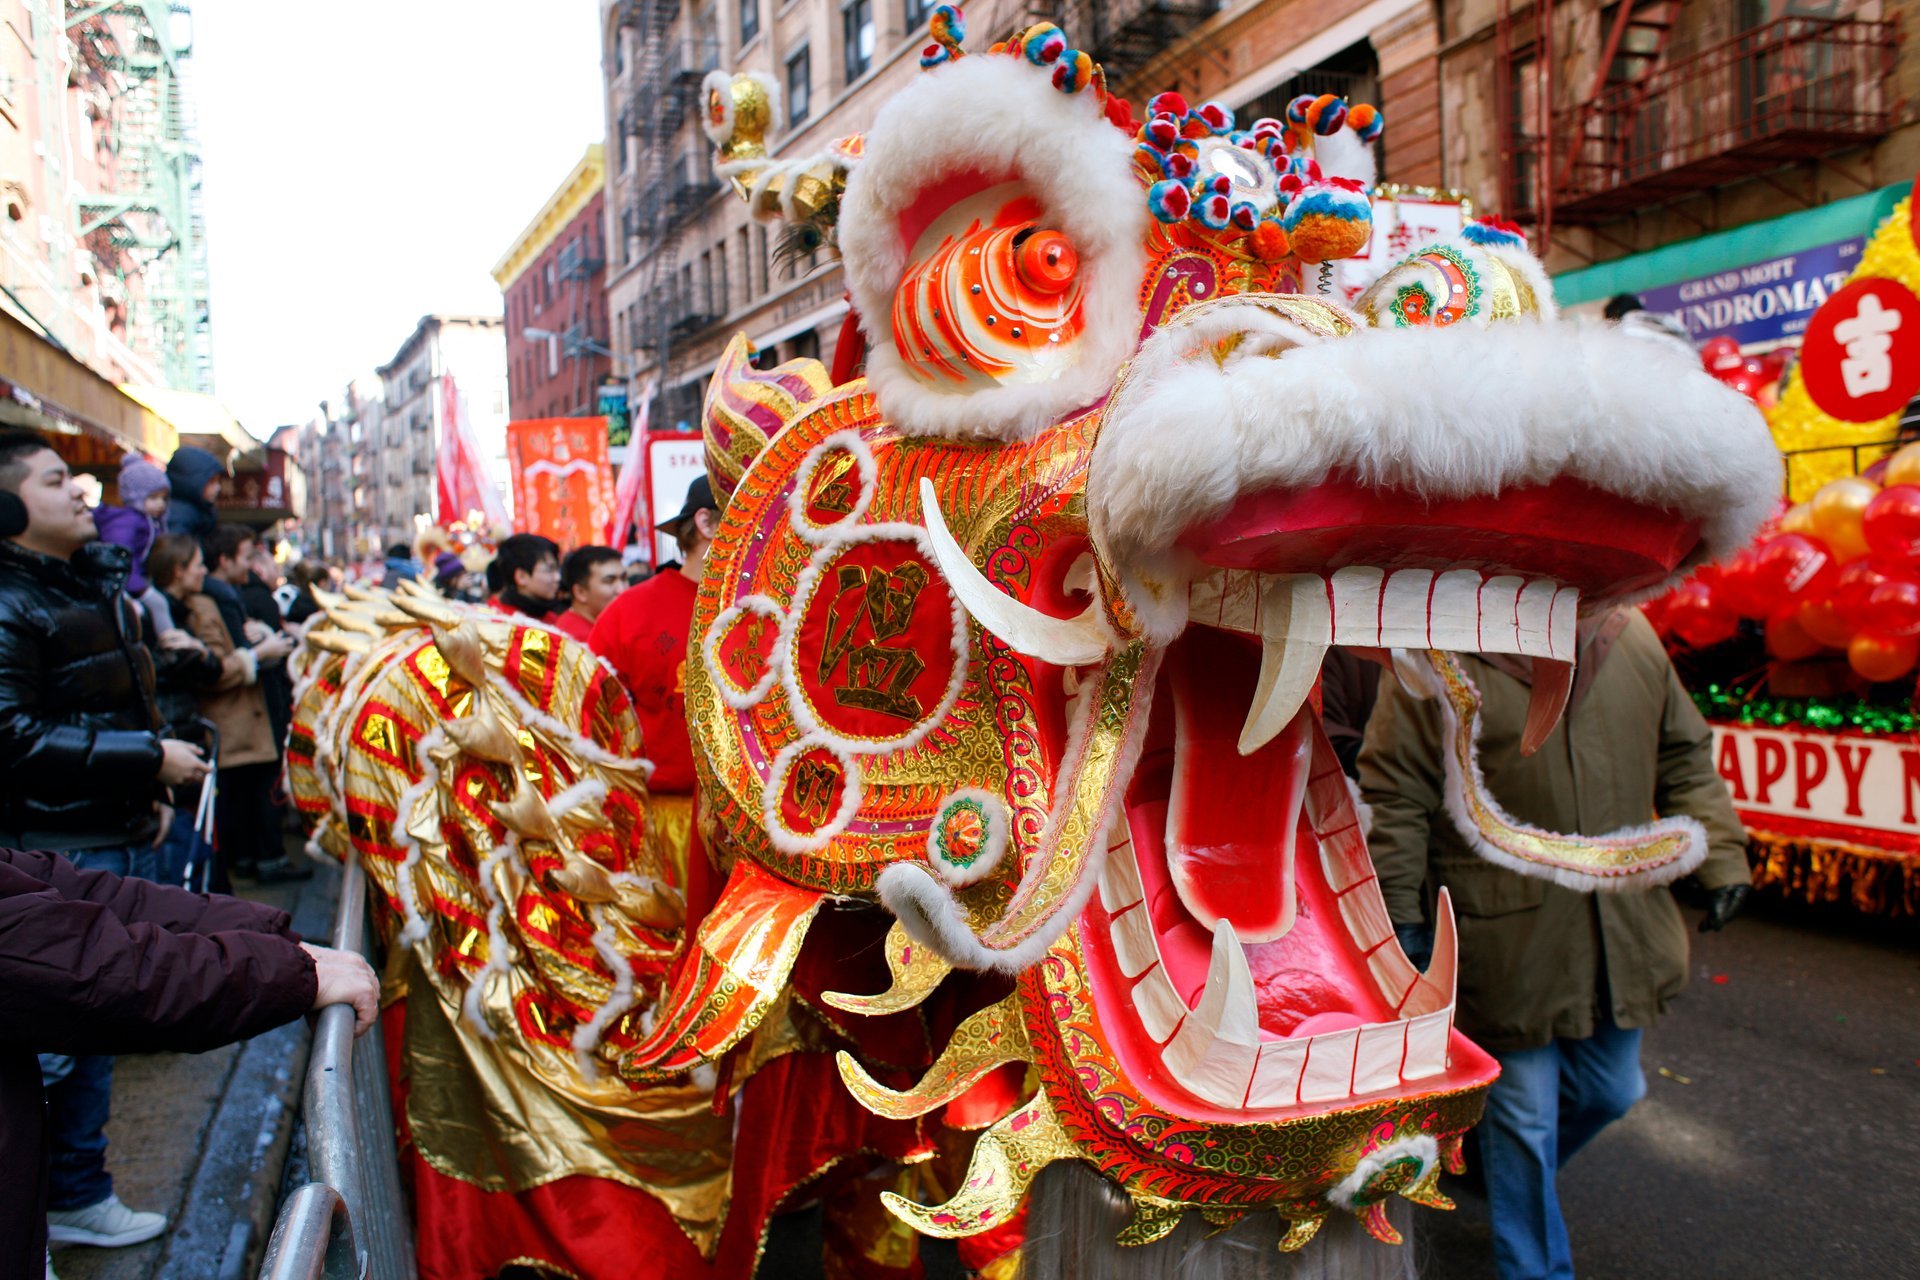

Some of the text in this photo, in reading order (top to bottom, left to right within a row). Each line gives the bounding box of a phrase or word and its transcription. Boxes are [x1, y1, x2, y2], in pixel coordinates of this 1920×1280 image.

[1679, 256, 1796, 302] GRAND MOTT
[1833, 293, 1902, 398] 吉
